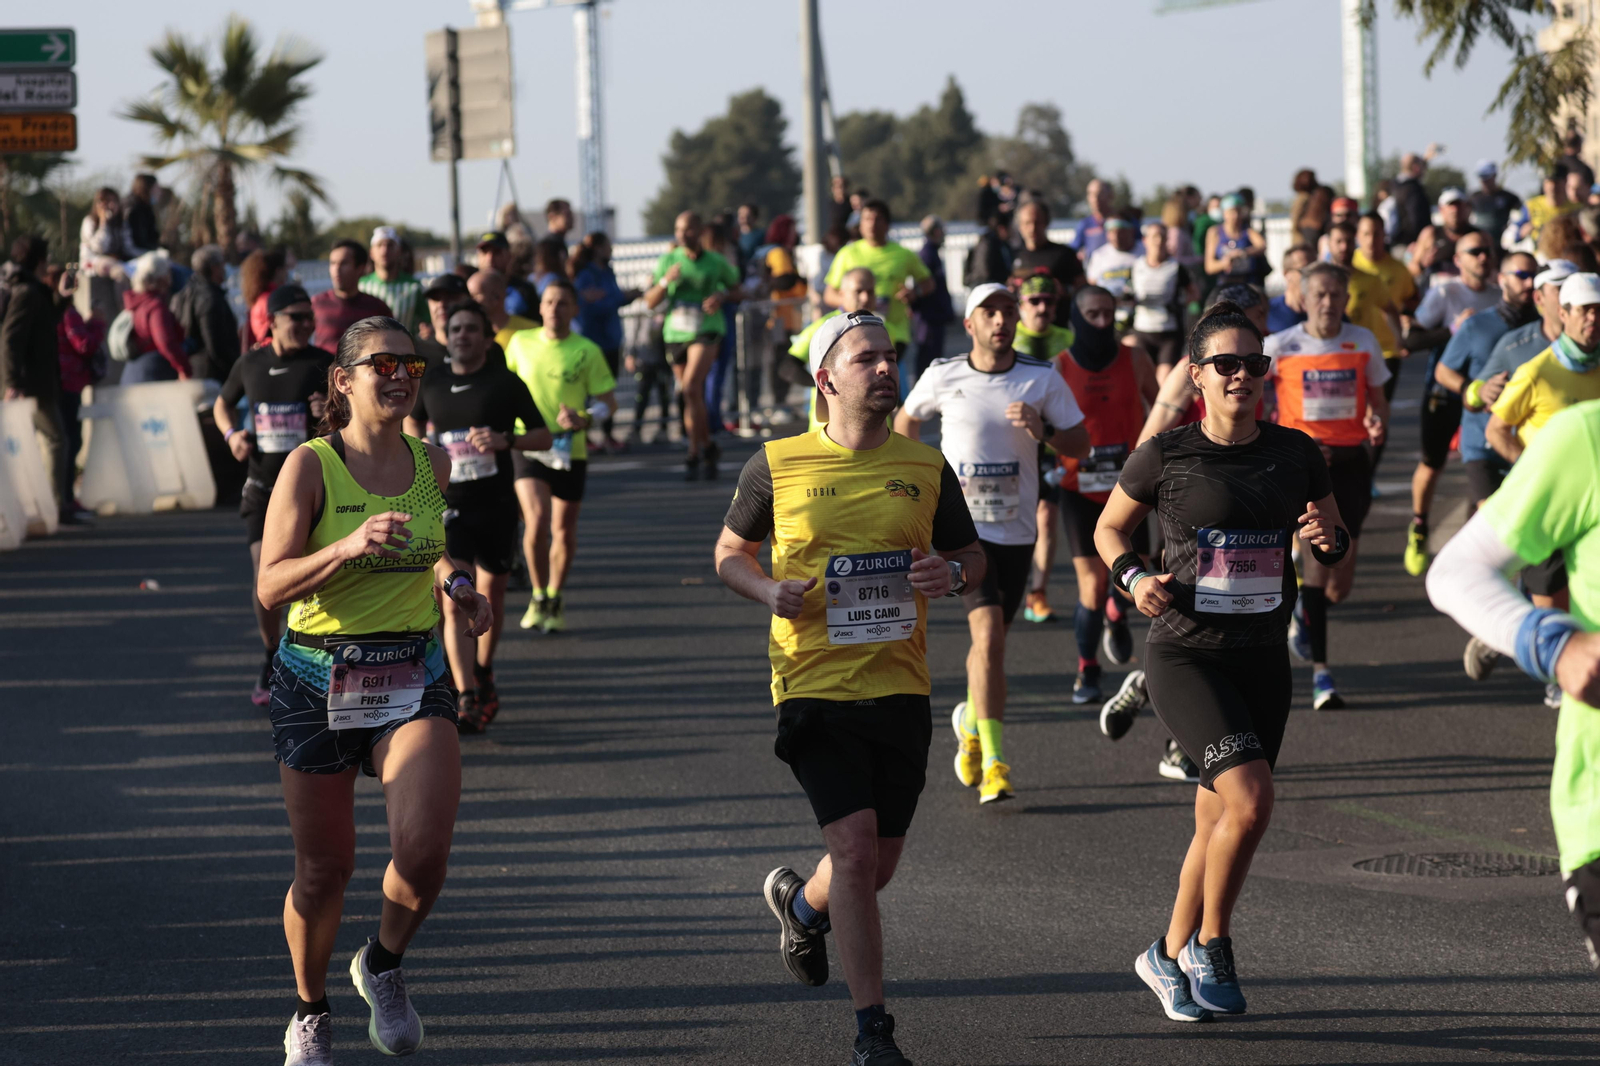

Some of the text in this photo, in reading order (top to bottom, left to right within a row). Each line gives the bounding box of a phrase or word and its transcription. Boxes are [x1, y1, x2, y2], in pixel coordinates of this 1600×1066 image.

[976, 465, 1014, 475] ZURICH
[806, 487, 837, 497] GOBIK
[335, 504, 366, 514] COFIDES
[1229, 534, 1278, 545] ZURICH
[344, 556, 401, 570] PRAZER
[856, 556, 905, 571] ZURICH
[1228, 560, 1257, 573] 7556
[858, 585, 889, 601] 8716
[848, 607, 900, 622] LUIS CANO
[365, 645, 416, 662] ZURICH
[362, 674, 392, 689] 6911
[360, 695, 390, 705] FIFAS
[1204, 732, 1263, 769] ASIC
